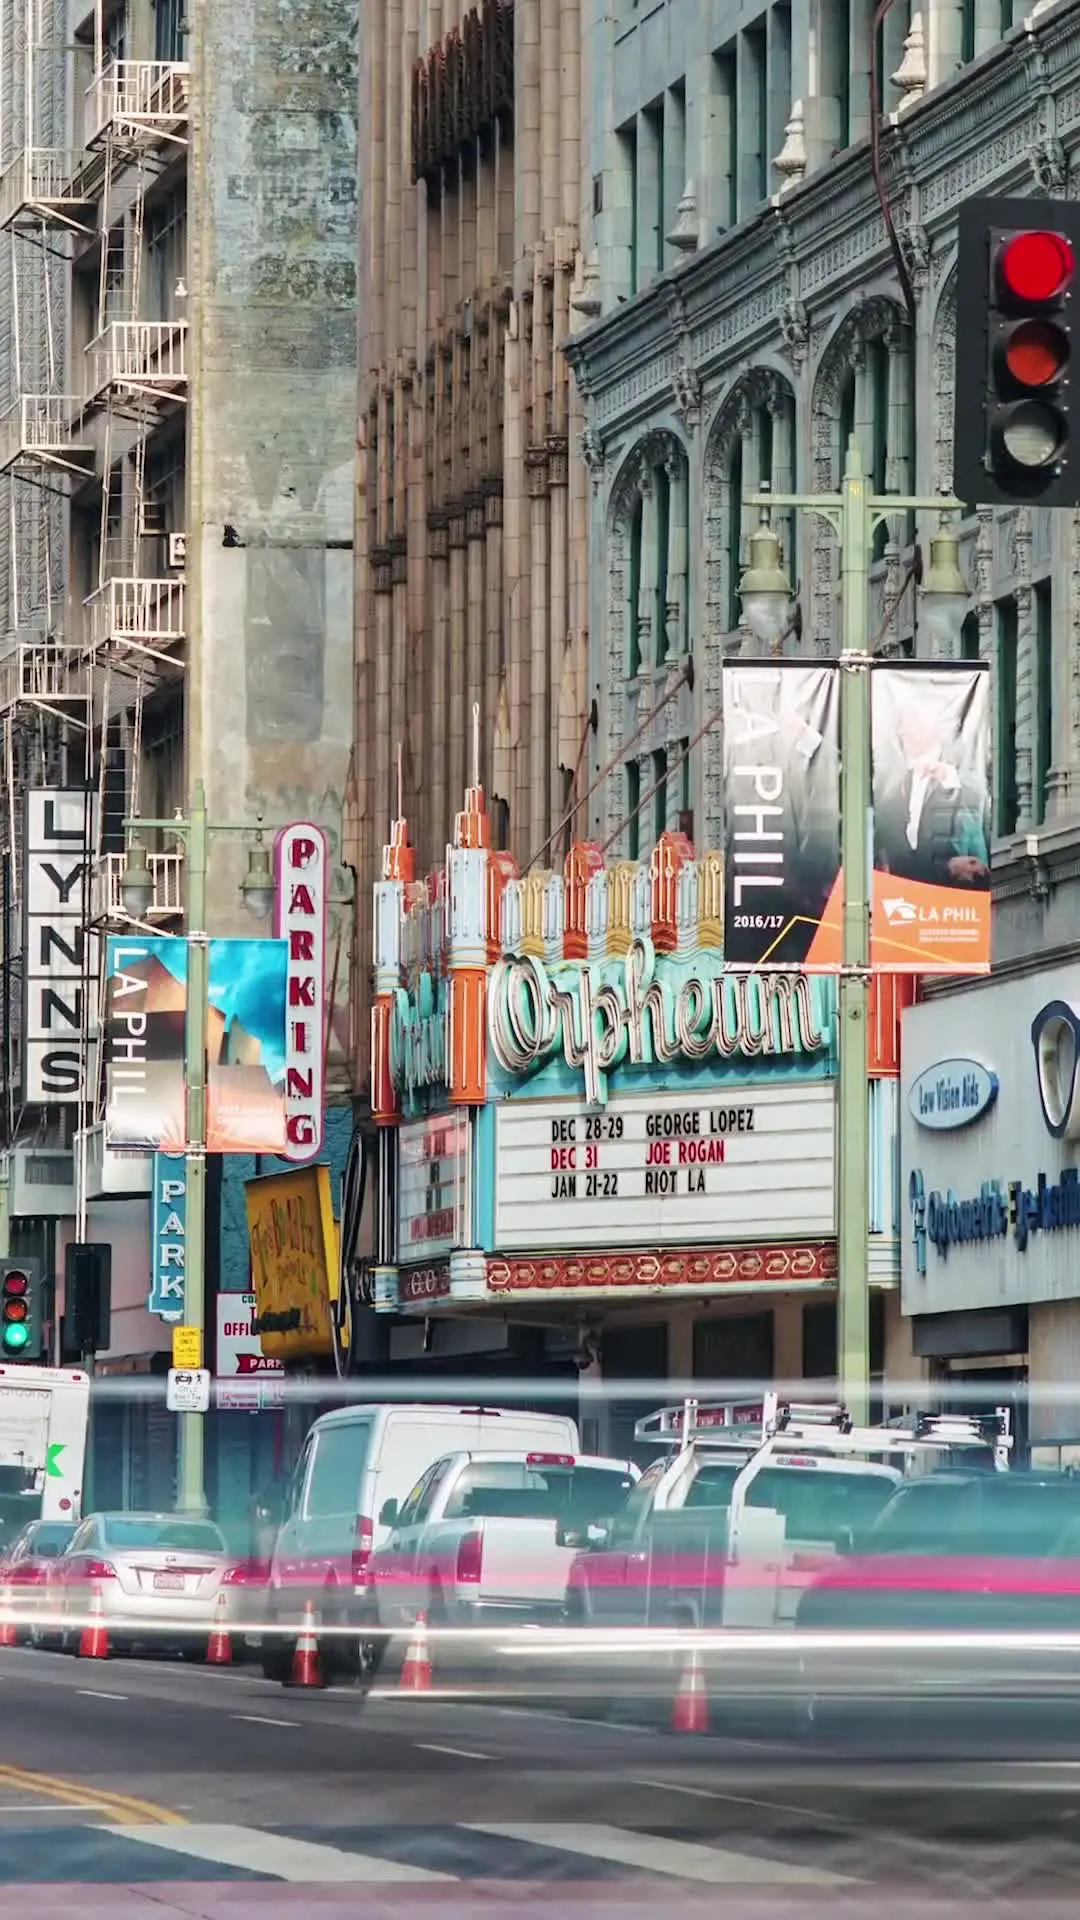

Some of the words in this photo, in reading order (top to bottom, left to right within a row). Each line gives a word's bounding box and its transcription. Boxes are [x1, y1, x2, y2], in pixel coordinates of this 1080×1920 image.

[732, 672, 781, 744] LA
[733, 766, 784, 907] PHIL
[733, 915, 785, 929] 2016/17
[919, 906, 939, 922] LA
[943, 907, 982, 922] PHIL
[40, 799, 85, 1095] LYNNS
[112, 947, 148, 998] LA
[285, 837, 318, 1146] PARKING
[488, 937, 830, 1105] Orpheum
[111, 1012, 147, 1107] PHIL
[551, 1118, 576, 1142] DEC
[585, 1115, 624, 1140] 28-29
[646, 1110, 700, 1138] GEORGE
[710, 1108, 755, 1133] LOPEZ
[919, 1083, 935, 1115] Low
[936, 1078, 961, 1112] Vision
[962, 1074, 979, 1108] Aids
[551, 1145, 576, 1170] DEC
[585, 1145, 599, 1168] 31
[645, 1142, 673, 1165] JOE
[678, 1139, 725, 1164] ROGAN
[551, 1175, 576, 1198] JAN
[585, 1173, 618, 1197] 21-22
[645, 1171, 677, 1194] RIOT
[688, 1169, 706, 1192] LA
[160, 1180, 185, 1299] PARK
